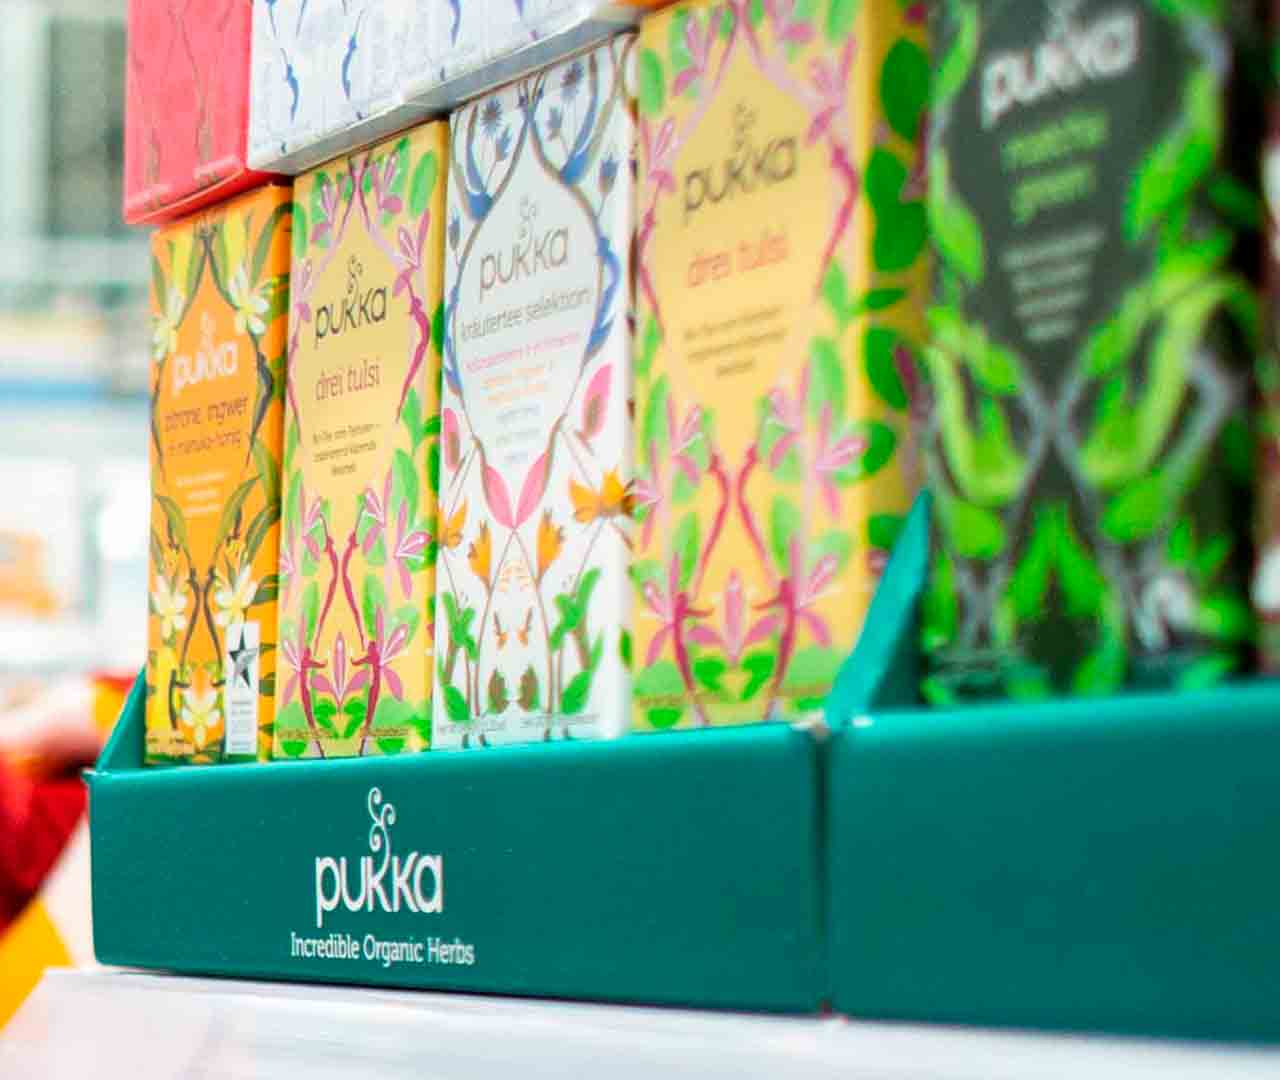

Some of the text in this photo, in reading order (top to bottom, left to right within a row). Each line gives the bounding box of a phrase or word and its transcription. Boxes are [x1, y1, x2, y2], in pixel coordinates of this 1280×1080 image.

[980, 0, 1139, 128] pukka
[684, 104, 796, 225] pukka
[479, 197, 569, 302] pukka
[314, 255, 387, 349] pukka
[172, 310, 239, 397] pukka
[315, 357, 381, 400] drei tulsi
[314, 786, 443, 928] pukka
[291, 931, 475, 967] Incredible Organic Herbs
